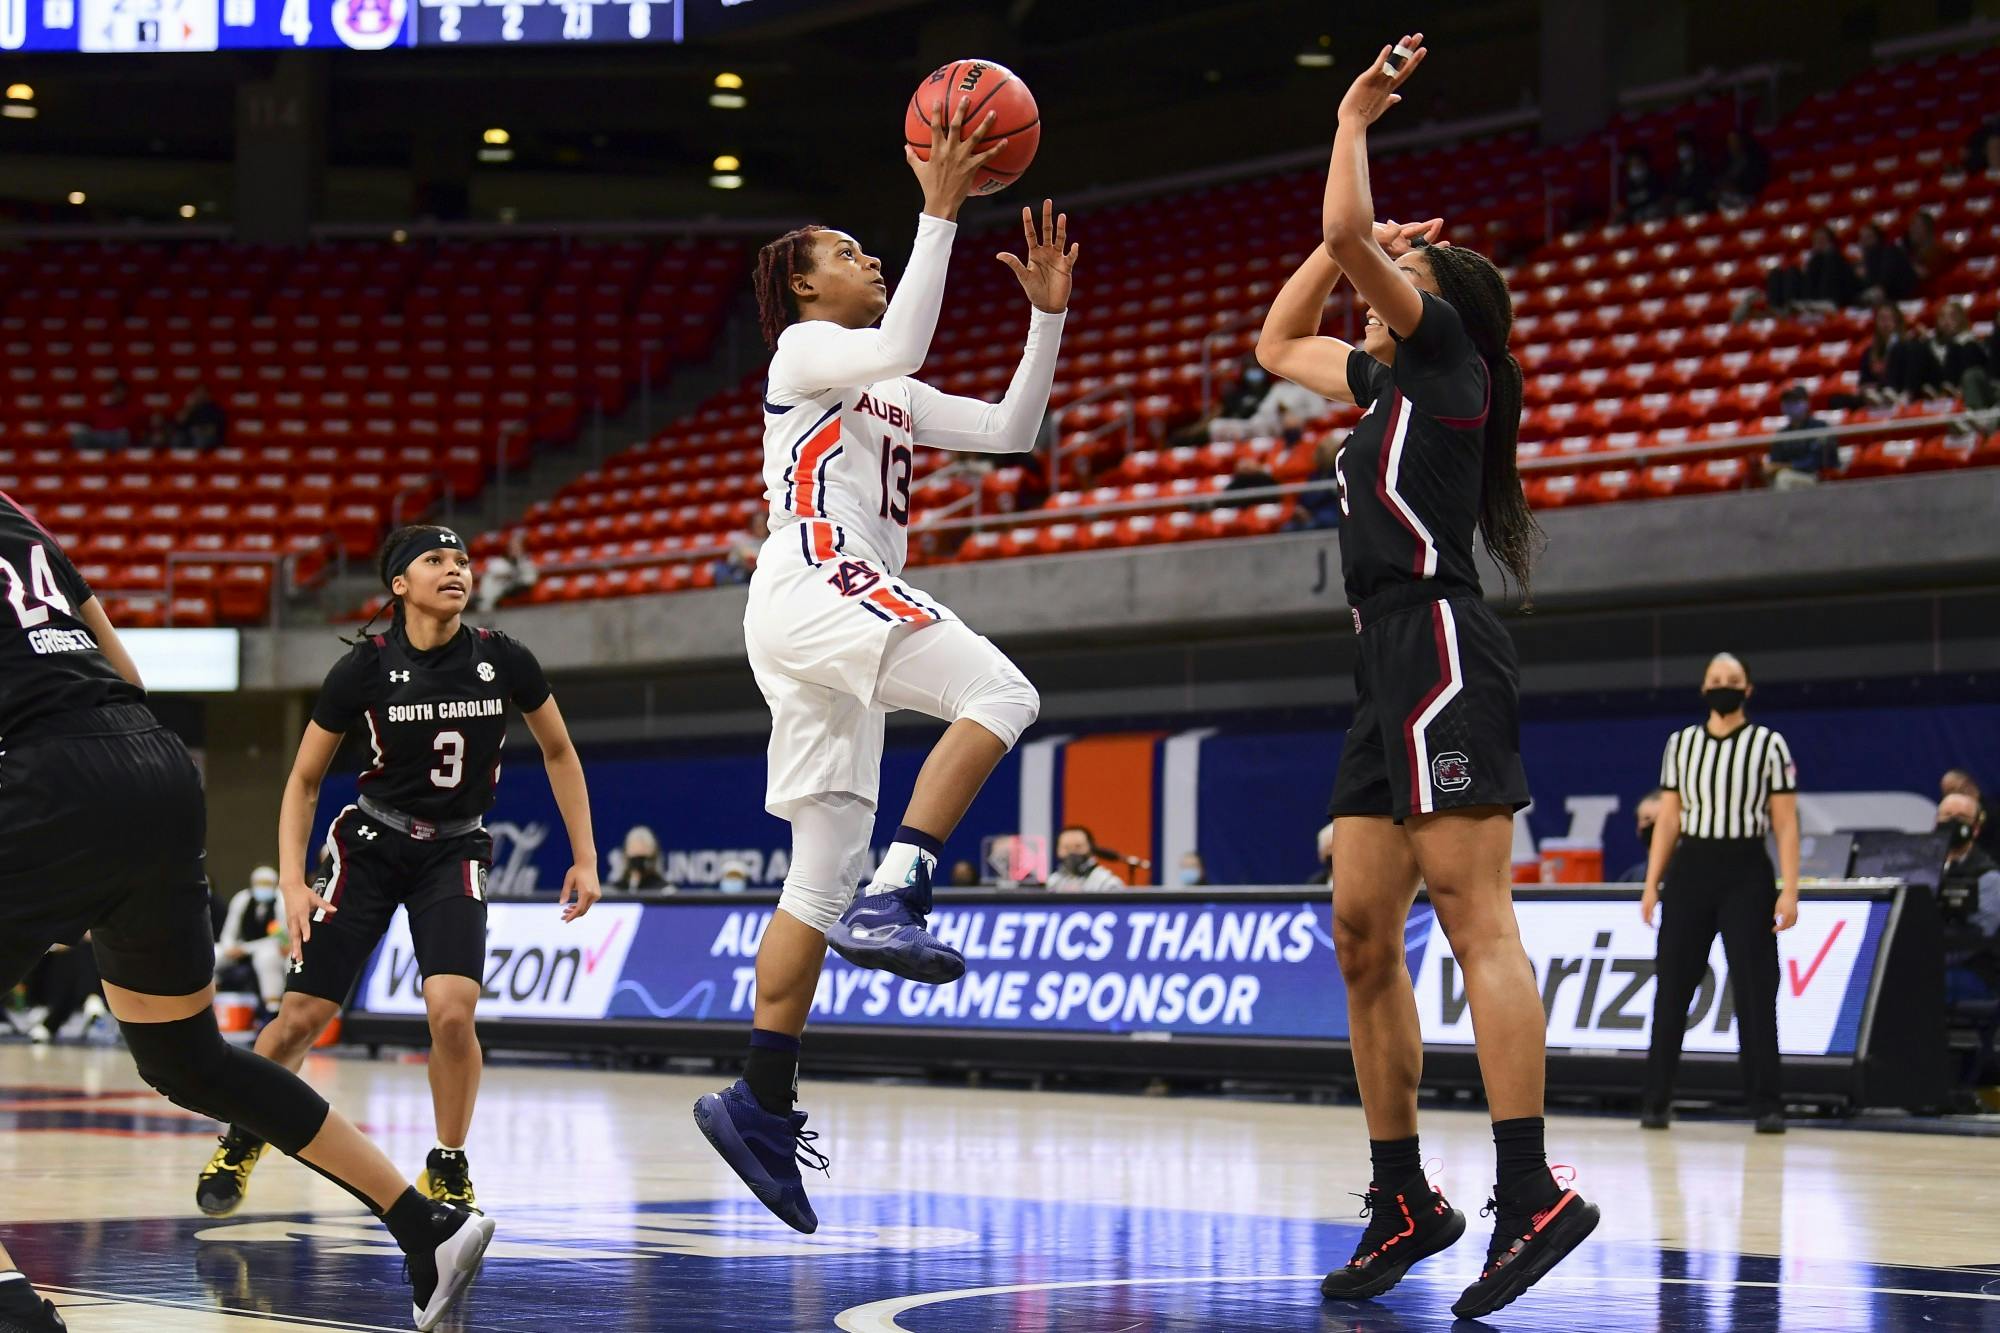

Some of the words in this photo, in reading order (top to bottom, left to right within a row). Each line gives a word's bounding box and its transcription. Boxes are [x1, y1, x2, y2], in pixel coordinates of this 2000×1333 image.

[879, 435, 912, 527] 13
[0, 544, 72, 629] 24
[388, 704, 434, 722] SOUTH
[438, 698, 503, 719] CAROLINA
[430, 731, 465, 788] 3
[924, 910, 1118, 960] THLETICS
[1126, 911, 1318, 963] THANKS
[386, 928, 582, 1003] vzon
[898, 969, 1030, 1020] GAME
[1030, 970, 1261, 1025] SPONSOR
